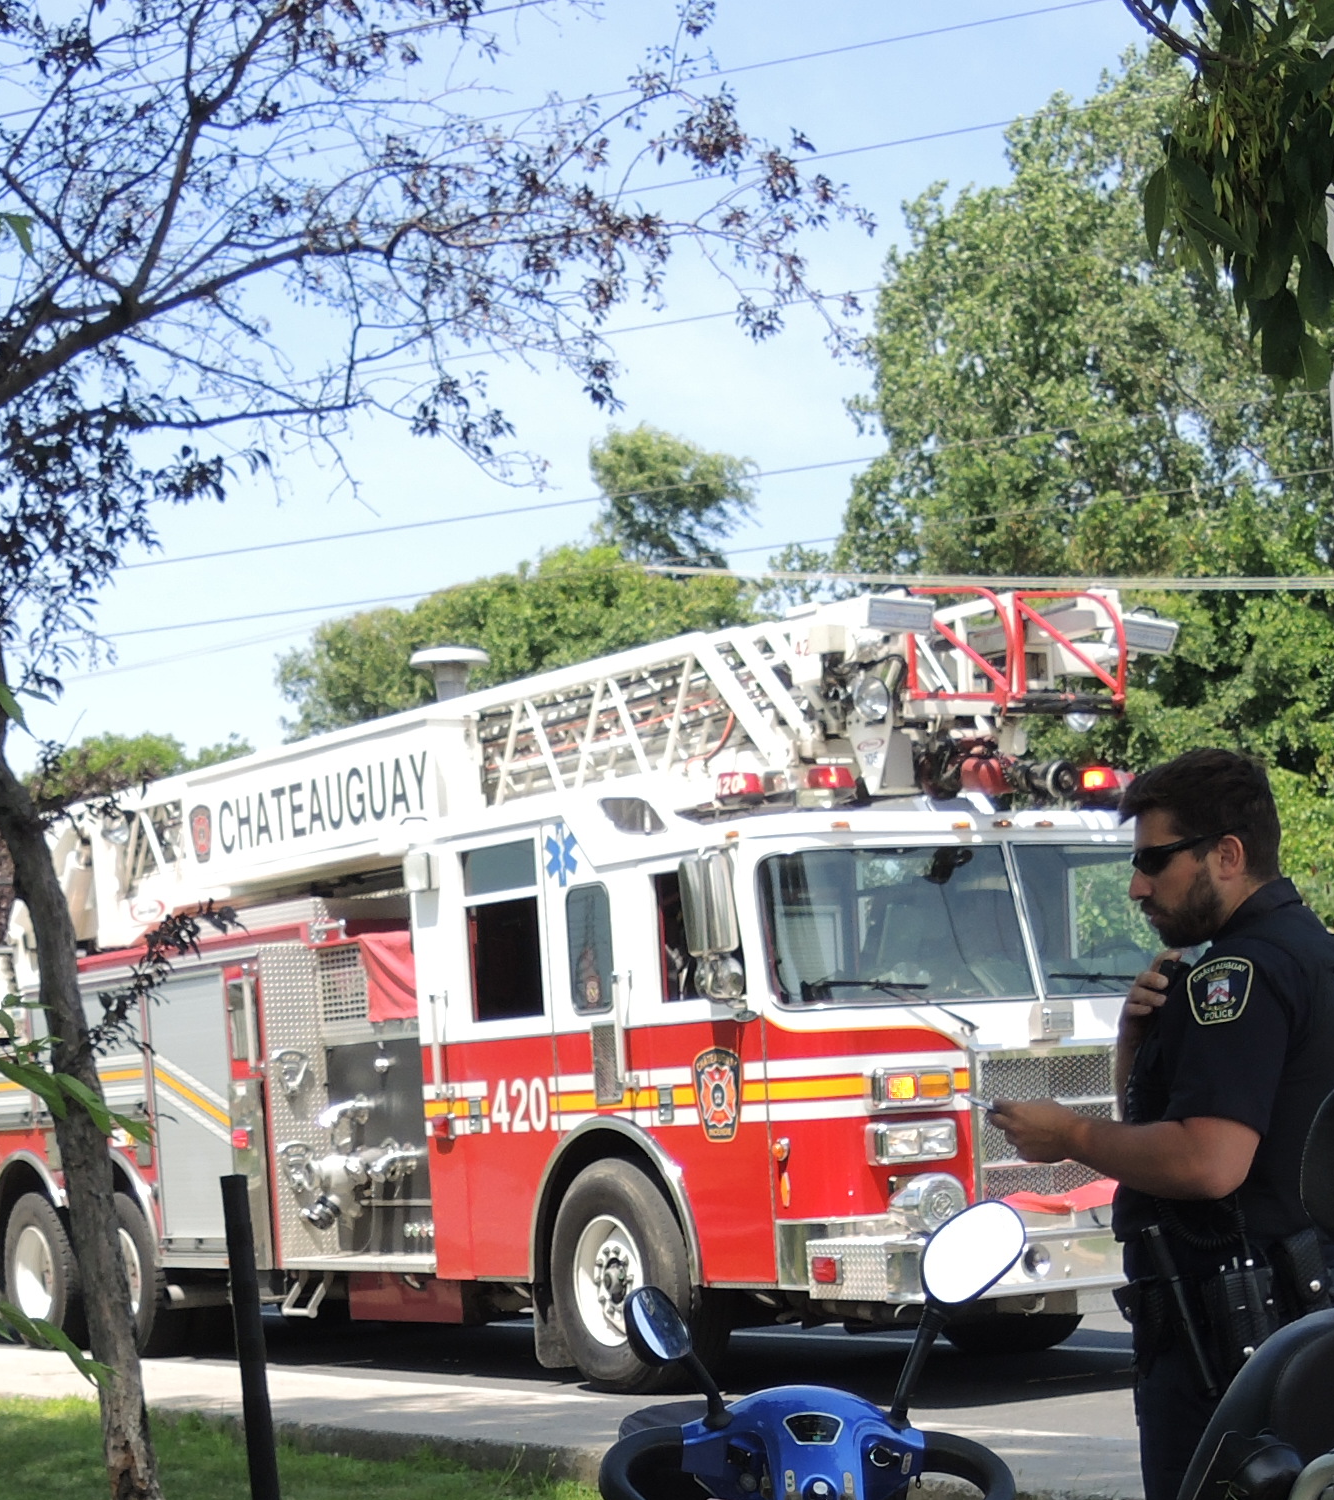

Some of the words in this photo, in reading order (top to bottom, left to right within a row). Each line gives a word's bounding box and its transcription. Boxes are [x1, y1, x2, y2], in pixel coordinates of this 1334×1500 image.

[219, 750, 427, 854] CHATEAUGUAY
[1204, 1009, 1234, 1020] POLICE
[491, 1076, 548, 1134] 420
